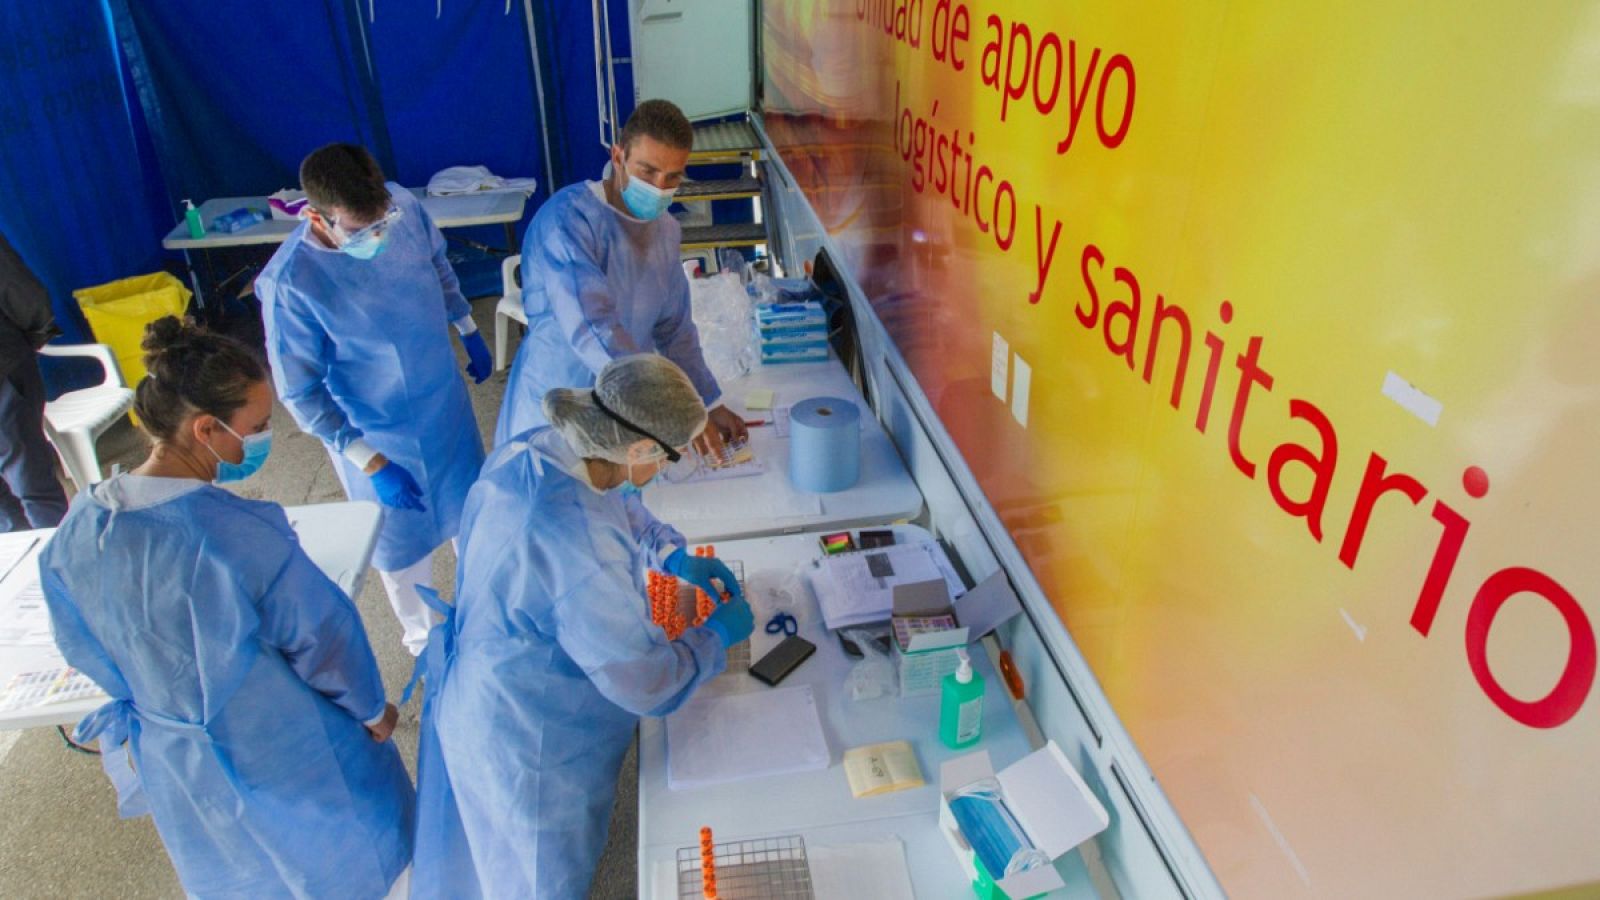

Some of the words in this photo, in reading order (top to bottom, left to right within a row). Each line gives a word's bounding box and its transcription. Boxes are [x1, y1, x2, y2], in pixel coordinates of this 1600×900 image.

[931, 0, 971, 71] de
[981, 14, 1136, 154] apoyo
[894, 81, 1017, 252] logístico
[1029, 205, 1063, 305] y
[1074, 243, 1597, 729] sanitario
